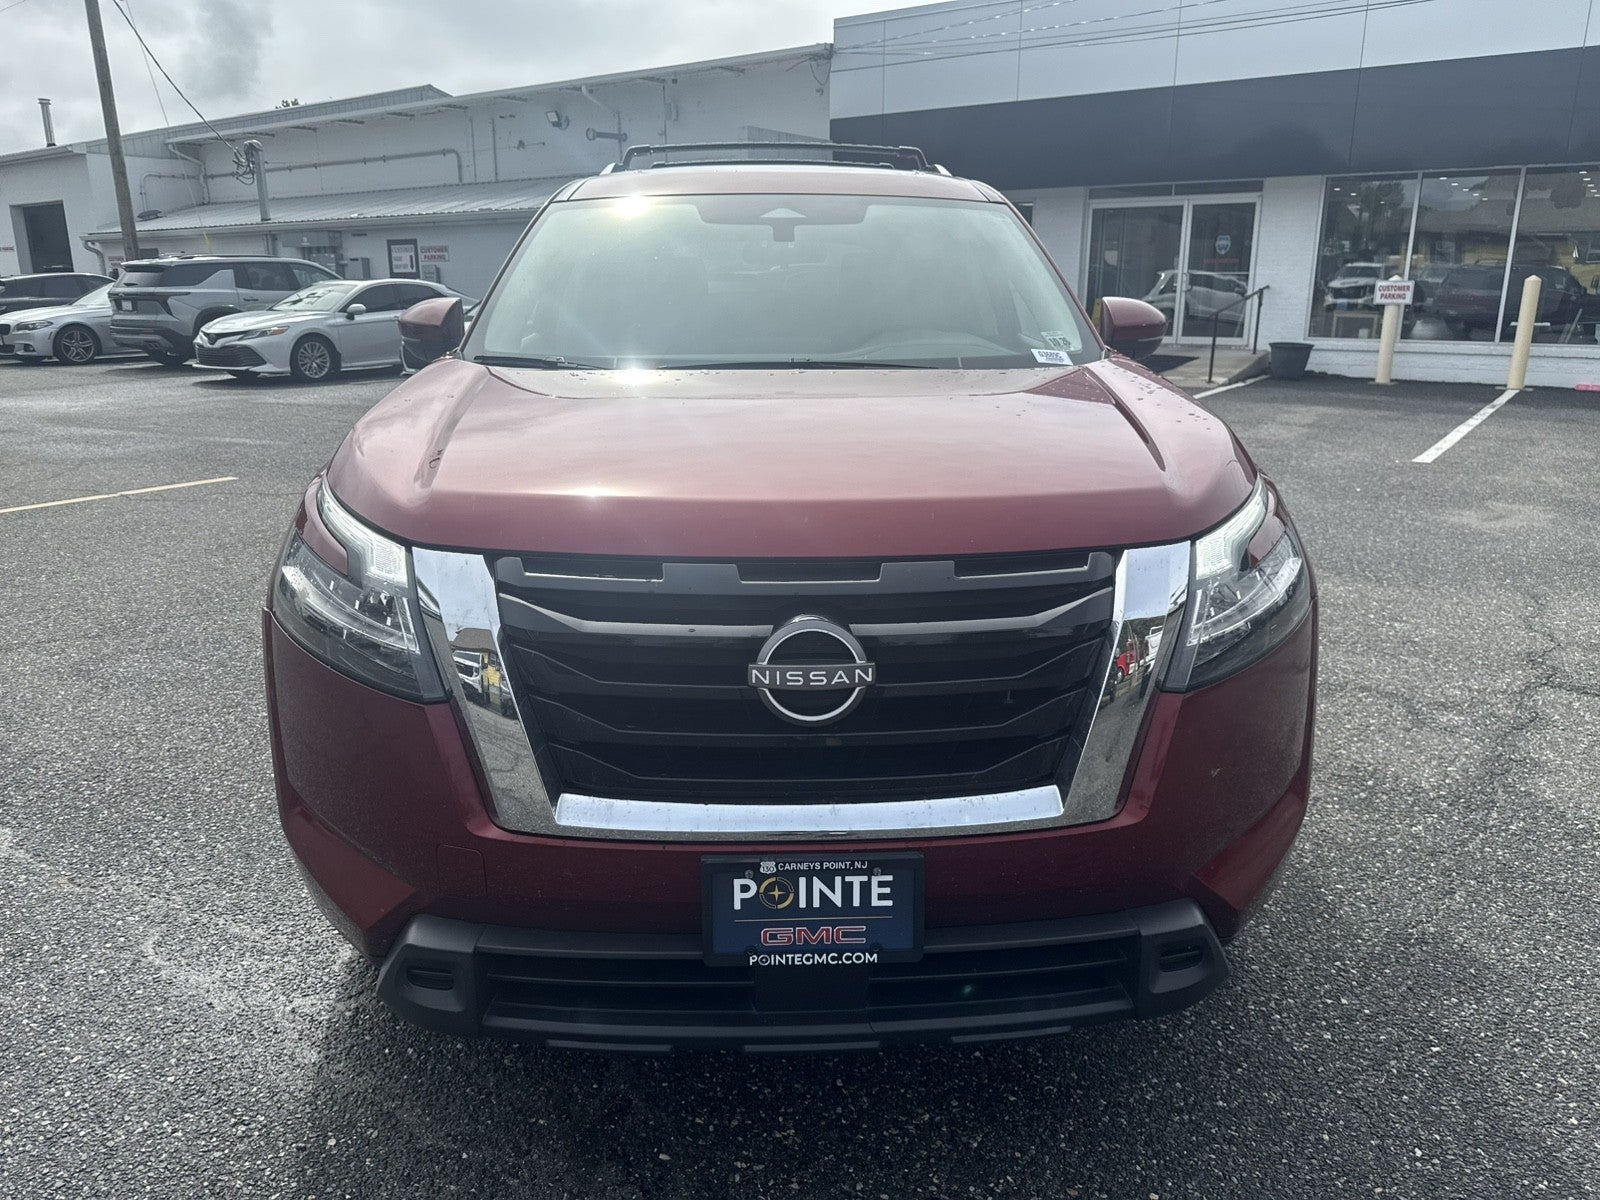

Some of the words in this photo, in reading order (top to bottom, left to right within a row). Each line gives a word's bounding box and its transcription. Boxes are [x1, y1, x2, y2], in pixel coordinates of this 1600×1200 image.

[1378, 284, 1411, 292] CUSTOMER
[1380, 292, 1407, 300] PARKING
[752, 667, 872, 686] NISSAN
[761, 864, 776, 873] 130
[778, 862, 821, 871] CARNEYS
[823, 861, 853, 870] POINT,
[854, 861, 868, 869] NJ
[733, 875, 894, 910] POINTE
[761, 926, 867, 946] GMC
[749, 952, 878, 966] POINTEGMC.COM
